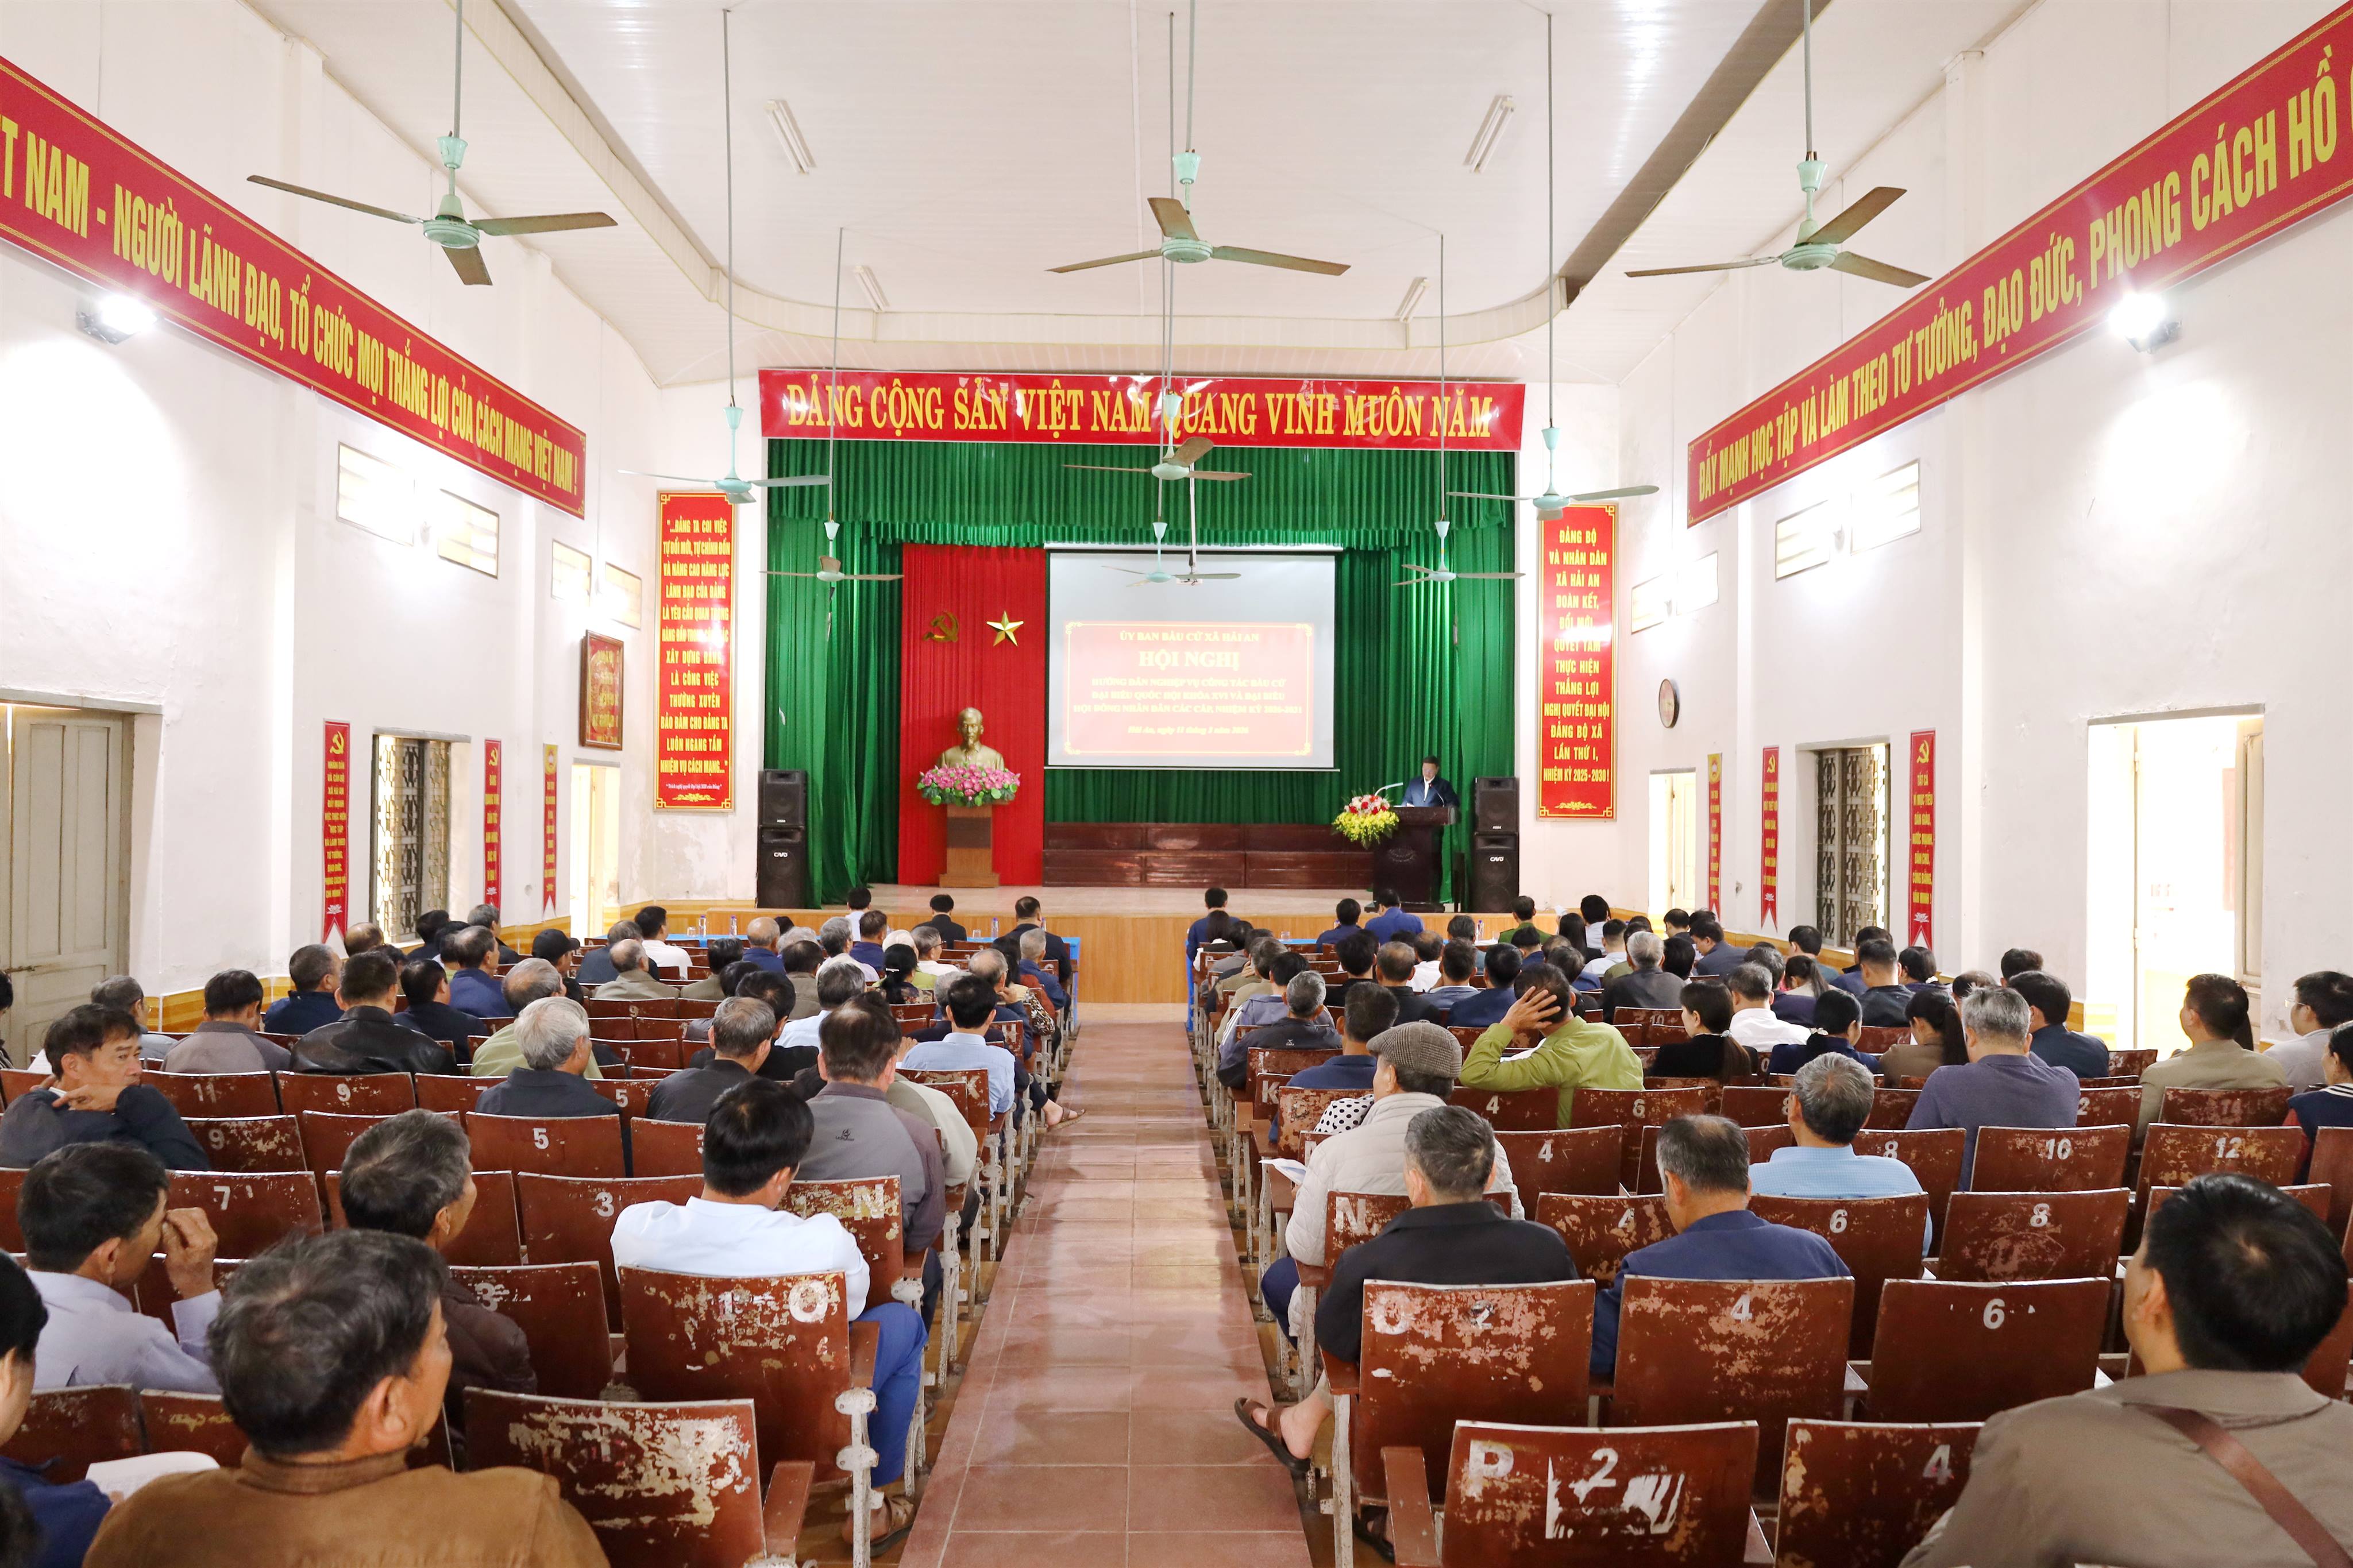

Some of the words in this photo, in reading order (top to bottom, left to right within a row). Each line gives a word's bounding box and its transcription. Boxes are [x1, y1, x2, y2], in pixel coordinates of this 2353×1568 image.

[1699, 439, 1717, 501] ĐẨY
[1719, 435, 1749, 495] MẠNH
[1752, 421, 1773, 479] HỌC
[1776, 401, 1798, 468] TẬP
[1802, 385, 1818, 447] VÀ
[1820, 374, 1849, 439] LÀM
[1853, 353, 1888, 420] THEO
[1893, 330, 1913, 399] TƯ
[1916, 297, 1978, 386] TƯỞNG,
[1984, 268, 2023, 354] ĐẠO
[2030, 231, 2082, 307] ĐỨC,
[2090, 171, 2181, 289] PHONG
[2190, 122, 2277, 231] CÁCH
[2288, 44, 2337, 180] HỒ
[25, 130, 89, 238] NAM
[114, 183, 183, 288] NGƯỜI
[189, 223, 240, 319] LÃNH
[245, 262, 284, 351] ĐẠO,
[290, 274, 310, 355] TỔ
[314, 305, 353, 379] CHỨC
[357, 330, 383, 405] MỌI
[388, 339, 428, 419] THẮNG
[431, 373, 449, 439] LỢI
[452, 375, 473, 444] CỦA
[476, 396, 502, 459] CÁCH
[505, 418, 531, 476] MẠNG
[534, 430, 553, 490] VIỆT
[554, 450, 572, 493] NAM
[787, 374, 862, 426] ĐẢNG
[870, 379, 944, 437] CỘNG
[954, 377, 1008, 430] SẢN
[1017, 379, 1083, 439] VIỆT
[1091, 391, 1151, 432] NAM
[1264, 393, 1334, 435] VINH
[1343, 386, 1424, 437] MUÔN
[1429, 390, 1492, 437] NĂM
[693, 520, 700, 533] TA
[701, 520, 712, 533] COI
[714, 517, 727, 536] VIỆC
[1559, 526, 1582, 543] ĐẢNG
[1586, 528, 1597, 546] BỘ
[663, 540, 670, 557] TỰ
[670, 536, 680, 554] ĐỔI
[693, 540, 701, 557] TỰ
[1549, 549, 1560, 565] VÀ
[1563, 549, 1586, 565] NHÂN
[1590, 550, 1607, 565] DÂN
[664, 561, 671, 576] VÀ
[672, 561, 688, 576] NÂNG
[689, 563, 700, 576] CAO
[701, 561, 718, 577] NĂNG
[718, 562, 730, 579] LỰC
[1556, 571, 1567, 586] XÃ
[1570, 569, 1585, 586] HẢI
[1588, 574, 1600, 586] AN
[666, 582, 681, 598] LÃNH
[682, 585, 695, 601] ĐẠO
[696, 581, 708, 598] CỦA
[709, 581, 726, 598] ĐẢNG
[1557, 593, 1579, 608] ĐOÀN
[1582, 592, 1599, 610] KẾT,
[662, 604, 669, 620] LÀ
[670, 604, 681, 620] YÊU
[682, 603, 693, 620] CẦU
[694, 607, 709, 621] QUAN
[661, 625, 676, 642] HÀNG
[676, 624, 686, 642] ĐẦU
[1137, 632, 1159, 640] BAN
[666, 648, 679, 663] XÂY
[682, 650, 700, 666] DỰNG
[1139, 648, 1179, 671] HỘI
[1185, 651, 1240, 671] NGHỊ
[1555, 659, 1576, 676] THỰC
[1580, 658, 1599, 676] HIỆN
[671, 670, 679, 685] LÀ
[682, 670, 700, 685] CÔNG
[704, 671, 719, 689] VIỆC
[1555, 677, 1583, 694] THẮNG
[1586, 681, 1599, 698] LỢI
[669, 691, 696, 708] THƯỜNG
[699, 692, 720, 708] XUYÊN
[1544, 703, 1560, 719] NGHỊ
[1563, 700, 1583, 717] QUYẾT
[1584, 704, 1596, 720] ĐẠI
[1598, 701, 1610, 720] HỘI
[661, 712, 673, 729] BẢO
[674, 712, 688, 729] ĐẢM
[689, 716, 702, 729] CHO
[703, 712, 719, 729] ĐẢNG
[721, 717, 728, 729] TA
[1550, 721, 1573, 738] ĐẢNG
[1577, 723, 1588, 741] BỘ
[1591, 723, 1603, 738] XÃ
[666, 735, 684, 751] LUÔN
[685, 738, 707, 751] NGANG
[1574, 744, 1590, 760] THỨ
[661, 758, 678, 775] NHIỆM
[680, 760, 687, 775] VỤ
[688, 757, 703, 773] CÁCH
[1544, 766, 1563, 784] NHIỆM
[629, 1006, 639, 1018] 9
[621, 1048, 631, 1063] 7
[337, 1083, 351, 1102] 9
[615, 1090, 629, 1108] 5
[1262, 1080, 1280, 1104] K
[1486, 1095, 1499, 1114] 4
[1632, 1099, 1645, 1118] 6
[209, 1129, 225, 1149] 9
[534, 1128, 549, 1149] 5
[1538, 1142, 1553, 1163] 4
[1884, 1140, 1898, 1159] 8
[214, 1186, 231, 1210] 7
[595, 1191, 615, 1217] 3
[1335, 1196, 1367, 1235] N
[1829, 1209, 1848, 1233] 6
[2029, 1203, 2050, 1227] 8
[788, 1280, 830, 1323] O
[1730, 1294, 1753, 1322] 4
[1982, 1298, 2005, 1330] 6
[1465, 1439, 1515, 1498] P
[1590, 1447, 1619, 1488] 2
[1923, 1443, 1953, 1485] 4
